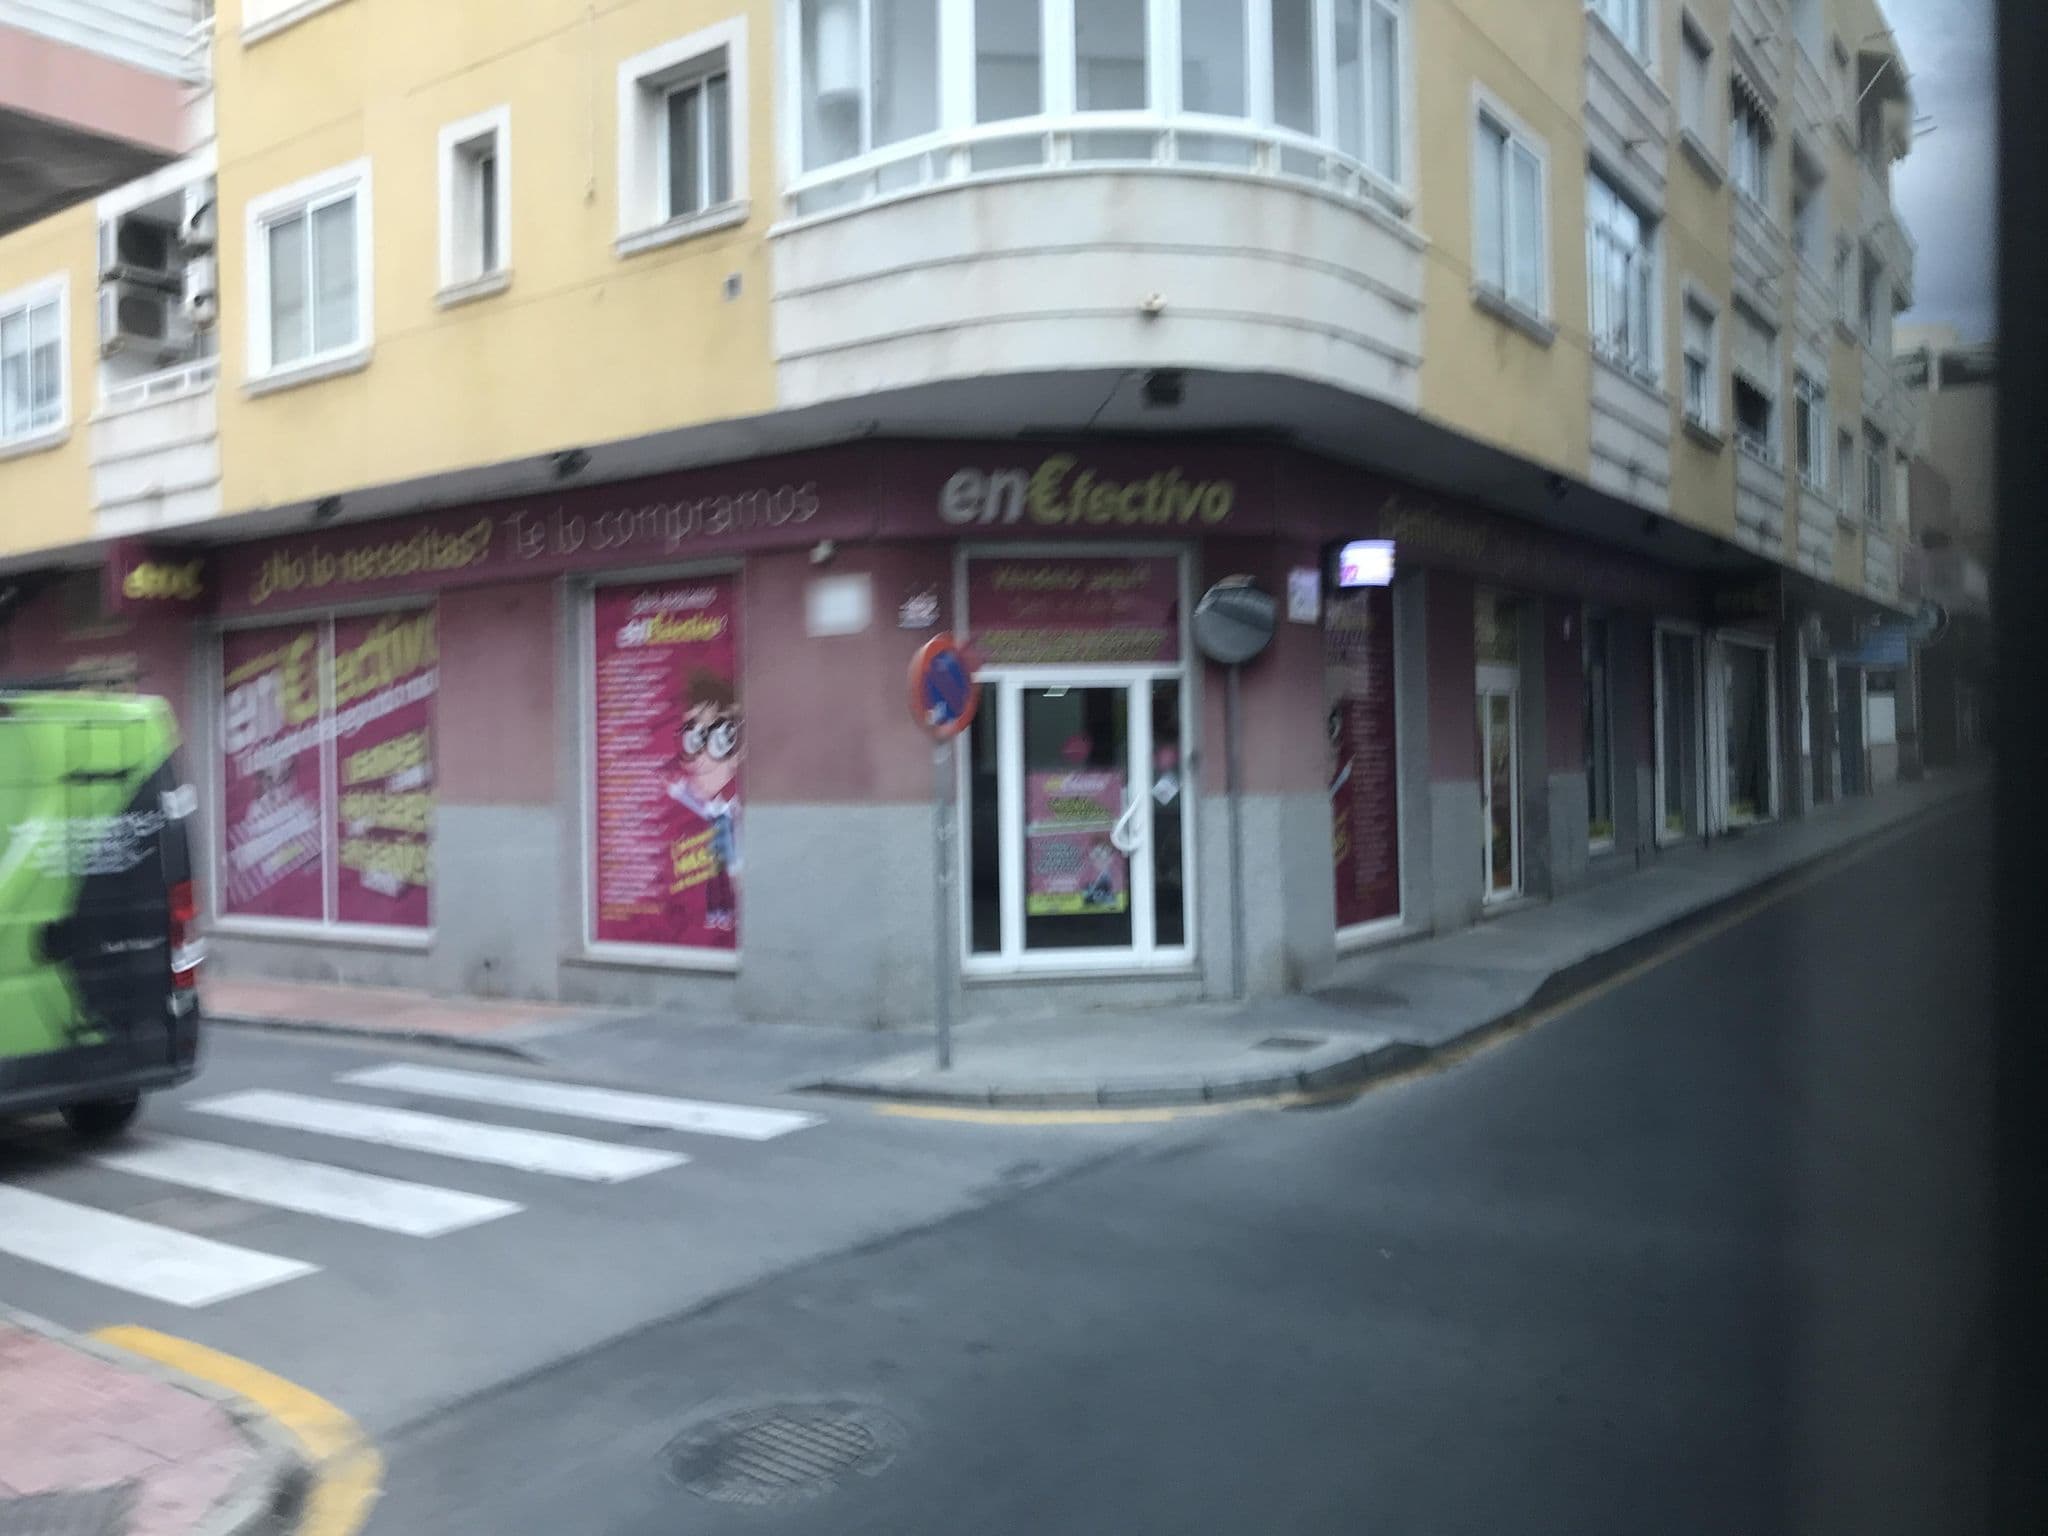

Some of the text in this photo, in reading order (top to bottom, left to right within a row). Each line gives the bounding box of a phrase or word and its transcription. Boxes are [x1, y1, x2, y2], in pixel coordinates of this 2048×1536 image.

[343, 517, 493, 582] necesitas?
[503, 508, 546, 559] Te
[553, 505, 586, 554] lo
[594, 481, 819, 553] compramos
